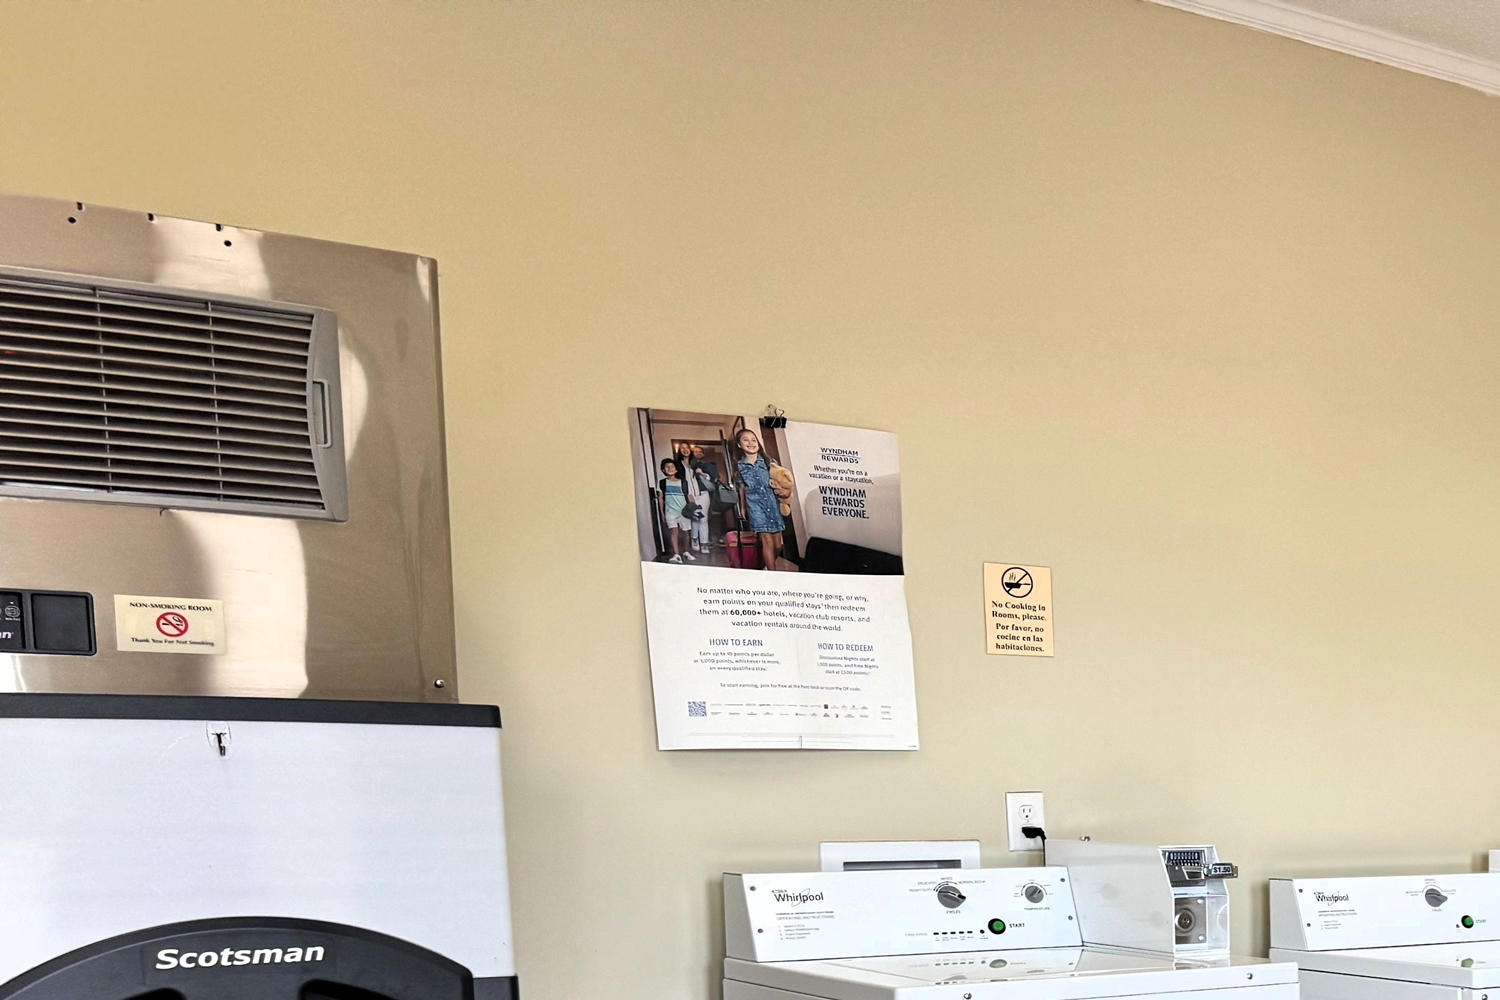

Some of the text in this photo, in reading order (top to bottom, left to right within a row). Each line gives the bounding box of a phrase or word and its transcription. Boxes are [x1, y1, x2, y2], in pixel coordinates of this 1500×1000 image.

[820, 447, 859, 456] WYNDHAM
[821, 455, 859, 464] REWARDS
[814, 465, 837, 473] Whether
[819, 485, 866, 498] WYNDHAM
[822, 496, 865, 508] REWARDS
[822, 506, 870, 519] EVERYONE.
[129, 602, 186, 610] NON-SMOKING
[775, 600, 804, 608] qualified
[992, 600, 1003, 608] No
[1005, 601, 1037, 612] Cooking
[764, 610, 788, 618] hotels,
[789, 611, 814, 619] vacation
[992, 611, 1047, 621] Rooms, please.
[1011, 624, 1033, 632] favor,
[709, 638, 763, 647] HOW TO EARN
[835, 643, 844, 651] TO
[846, 644, 874, 652] REDEEM
[995, 643, 1045, 652] habitaciones.
[774, 892, 824, 904] Whirlpool
[1314, 894, 1349, 903] Whirlpool
[155, 945, 324, 970] Scotsman
